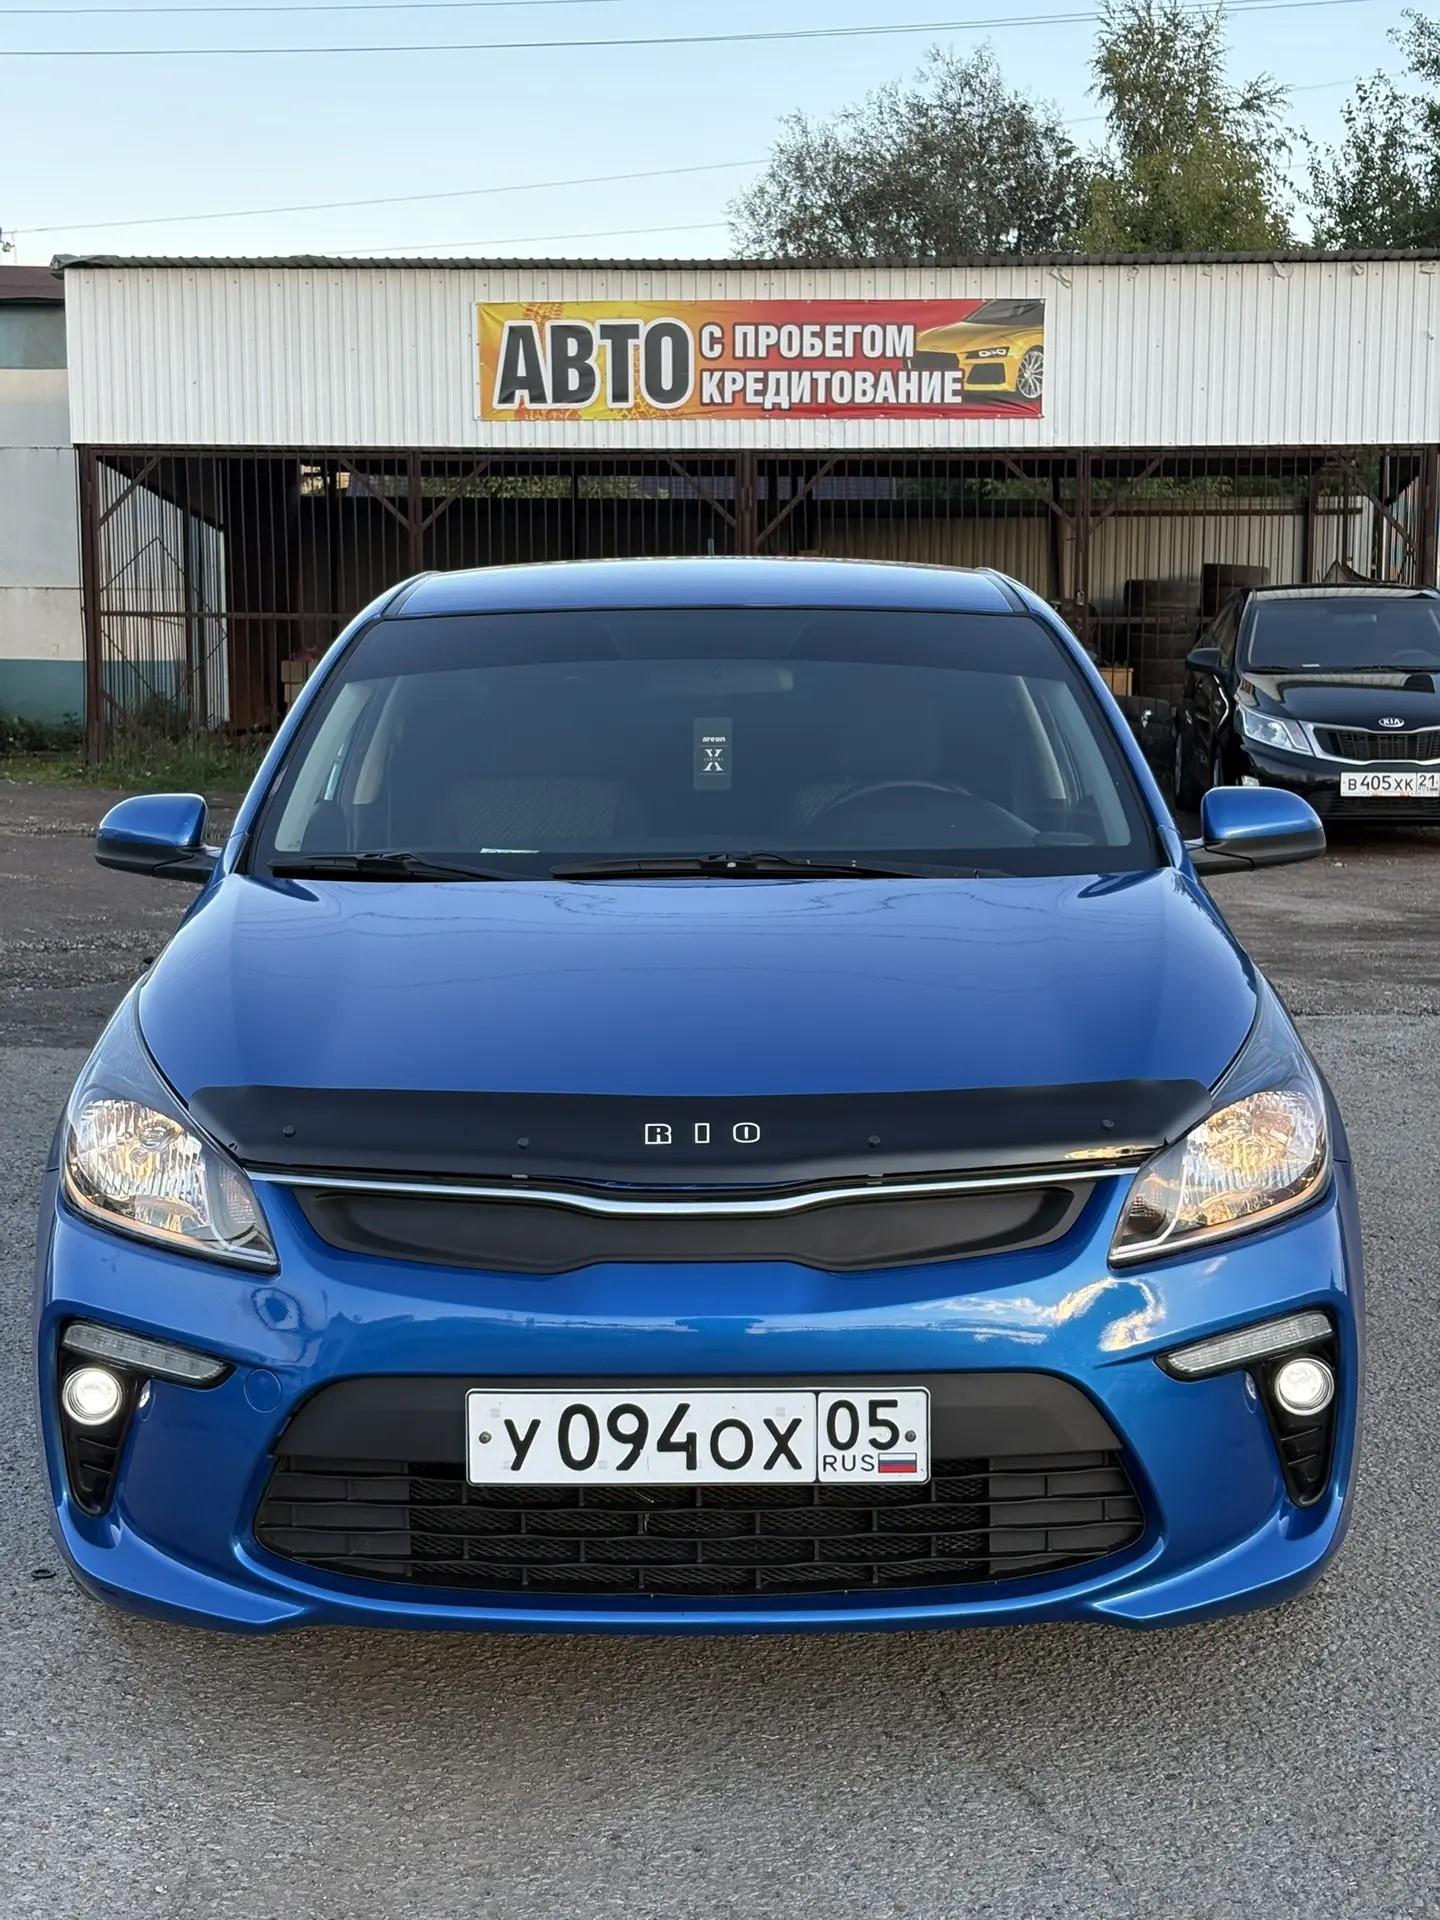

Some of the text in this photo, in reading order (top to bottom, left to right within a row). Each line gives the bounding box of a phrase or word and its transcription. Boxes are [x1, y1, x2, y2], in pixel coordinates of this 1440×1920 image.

[700, 323, 915, 361] С ПРОБЕГОМ
[495, 318, 694, 409] АВТО
[701, 370, 963, 410] КРЕДИТОВАНИЕ
[1382, 717, 1401, 725] KIA
[1418, 774, 1435, 787] 21
[644, 1122, 761, 1145] RIO
[504, 1399, 900, 1471] У094ОХ 05
[823, 1455, 875, 1473] RUS
